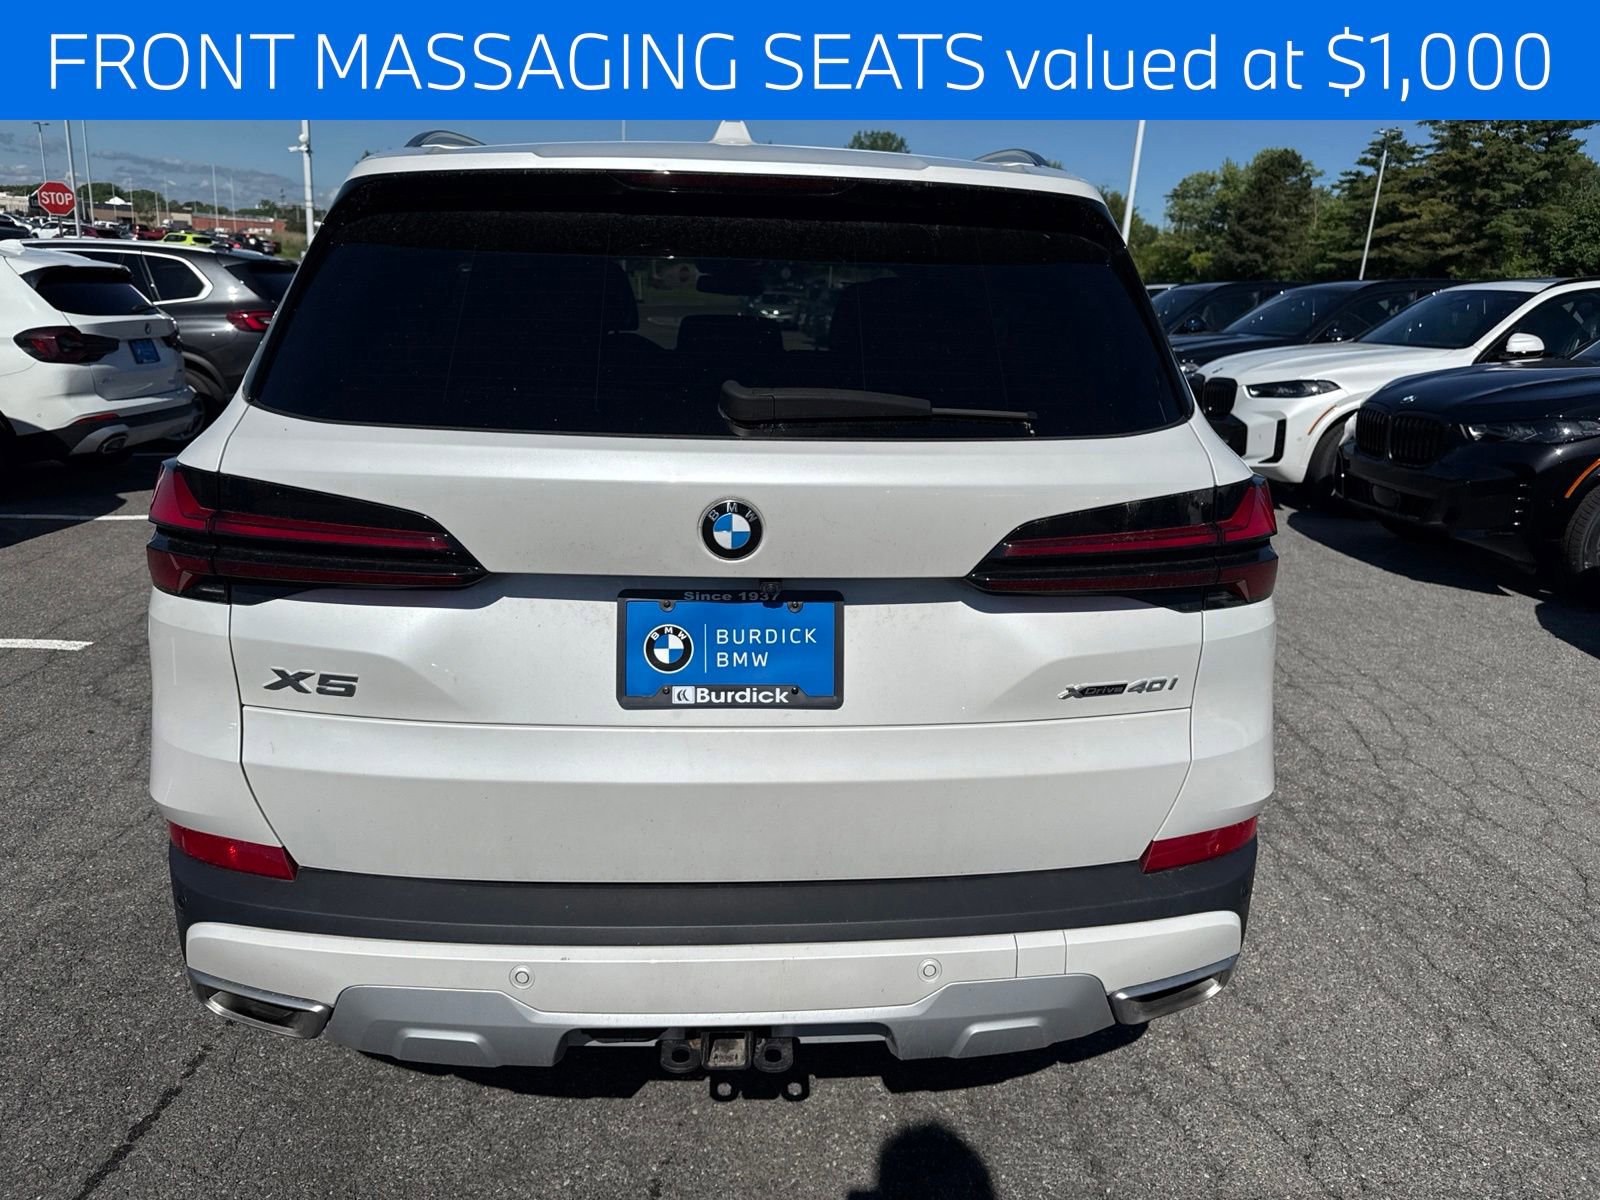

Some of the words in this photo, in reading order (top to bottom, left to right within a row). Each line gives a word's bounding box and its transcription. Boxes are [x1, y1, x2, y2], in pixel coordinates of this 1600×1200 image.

[41, 191, 73, 206] STOP
[708, 501, 757, 523] BMW
[683, 591, 733, 601] Since
[650, 626, 687, 641] BMW
[716, 628, 817, 645] BURDICK
[716, 651, 769, 667] BMW
[263, 666, 359, 698] X5
[696, 687, 789, 704] Burdick
